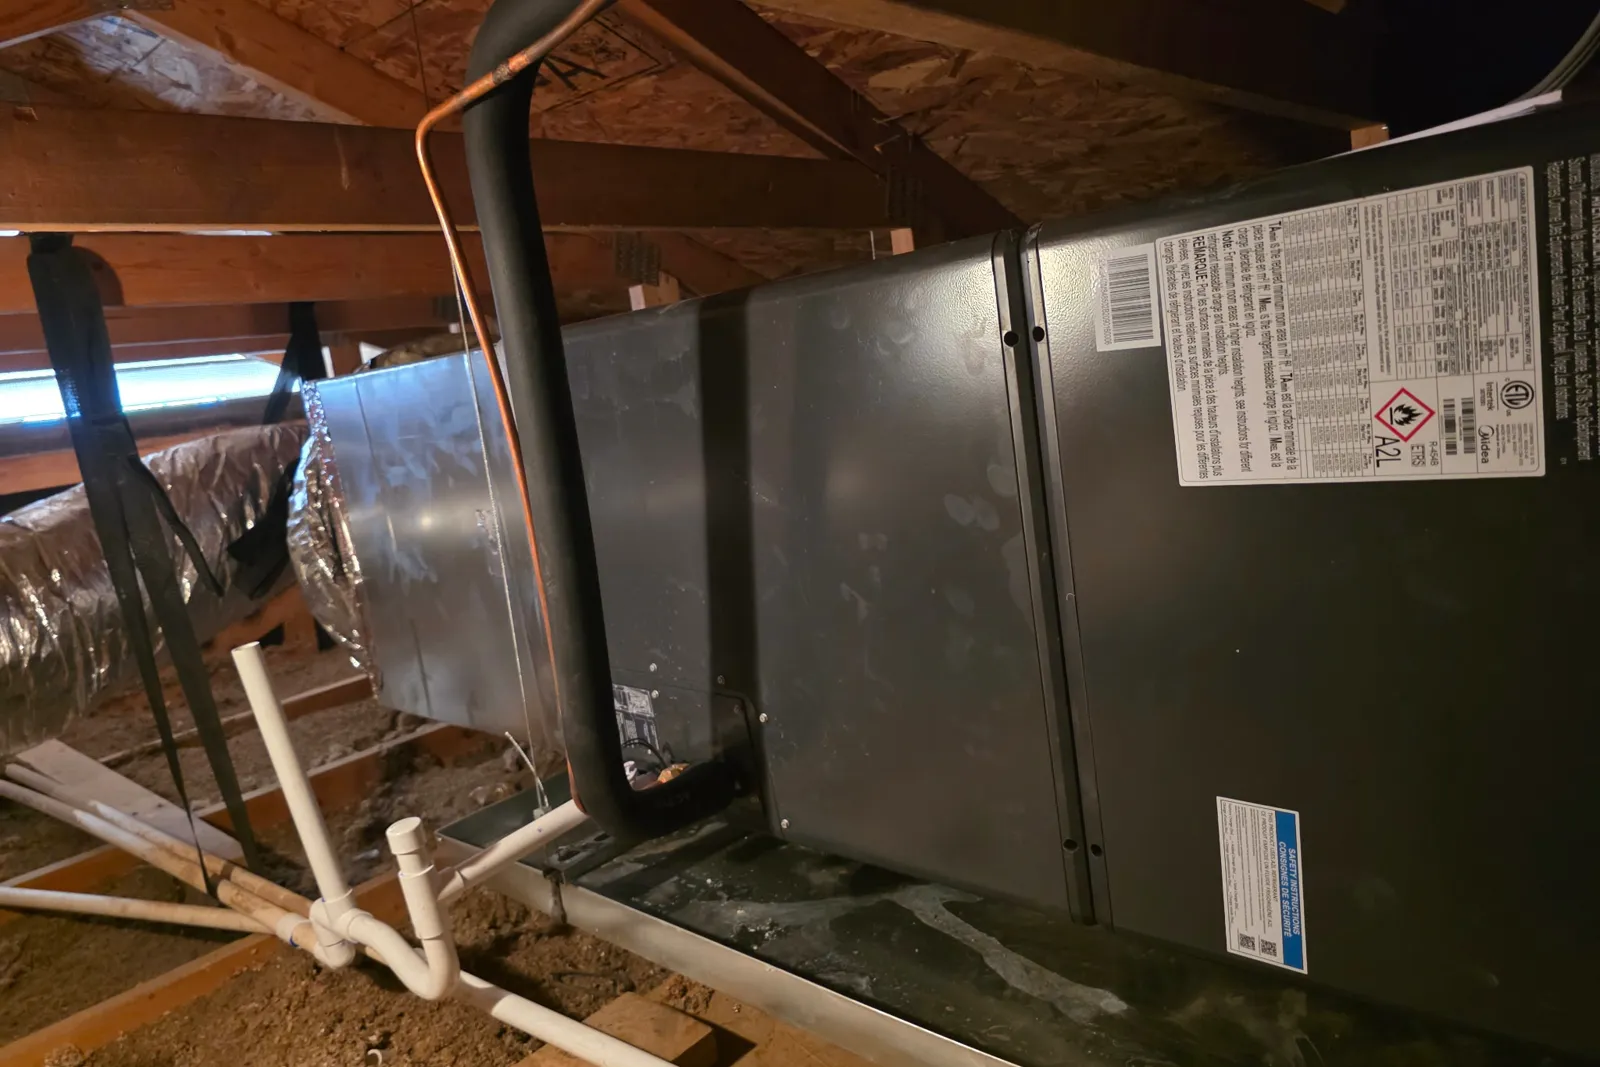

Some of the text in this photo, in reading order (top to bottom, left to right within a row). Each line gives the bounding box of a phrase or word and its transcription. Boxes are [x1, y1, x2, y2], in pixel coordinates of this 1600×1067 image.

[1221, 229, 1234, 250] Note:
[1160, 240, 1176, 264] charges
[1192, 235, 1208, 283] REMARQUE:
[1223, 251, 1235, 262] For
[1176, 262, 1190, 280] voyez
[1224, 261, 1238, 288] minimum
[1168, 291, 1179, 299] de
[1181, 279, 1193, 289] les
[1195, 283, 1208, 297] Pour
[1182, 289, 1196, 320] instructions
[1197, 297, 1209, 306] les
[1203, 232, 1230, 376] refrigerant releasable charge and installation heights.
[1226, 289, 1236, 304] room
[1197, 306, 1211, 330] surfaces
[1227, 304, 1238, 321] areas
[1185, 320, 1198, 344] relatives
[1226, 328, 1243, 347] higher
[1172, 334, 1185, 358] hauteurs
[1187, 344, 1197, 355] aux
[1200, 331, 1214, 358] minimales
[1188, 355, 1201, 379] surfaces
[1202, 359, 1215, 367] de
[1231, 347, 1245, 376] installation
[1190, 379, 1204, 406] minimales
[1230, 376, 1247, 398] heights,
[1485, 381, 1494, 410] Intertek
[1205, 394, 1218, 404] des
[1235, 399, 1245, 409] see
[1189, 406, 1206, 429] requises
[1206, 405, 1220, 428] hauteurs
[1236, 410, 1251, 440] instructions
[1192, 430, 1205, 442] pour
[1196, 442, 1208, 451] les
[1239, 441, 1251, 449] for
[1479, 431, 1490, 463] Midea
[1240, 450, 1253, 472] different
[1374, 434, 1401, 467] A2L
[1411, 445, 1425, 465] ETRS
[1429, 441, 1438, 465] R-454B
[1210, 465, 1224, 476] plus
[1278, 841, 1292, 937] CONSIGNES DE SÉCURITÉ
[1288, 847, 1300, 935] SAFETY INSTRUCTIONS
